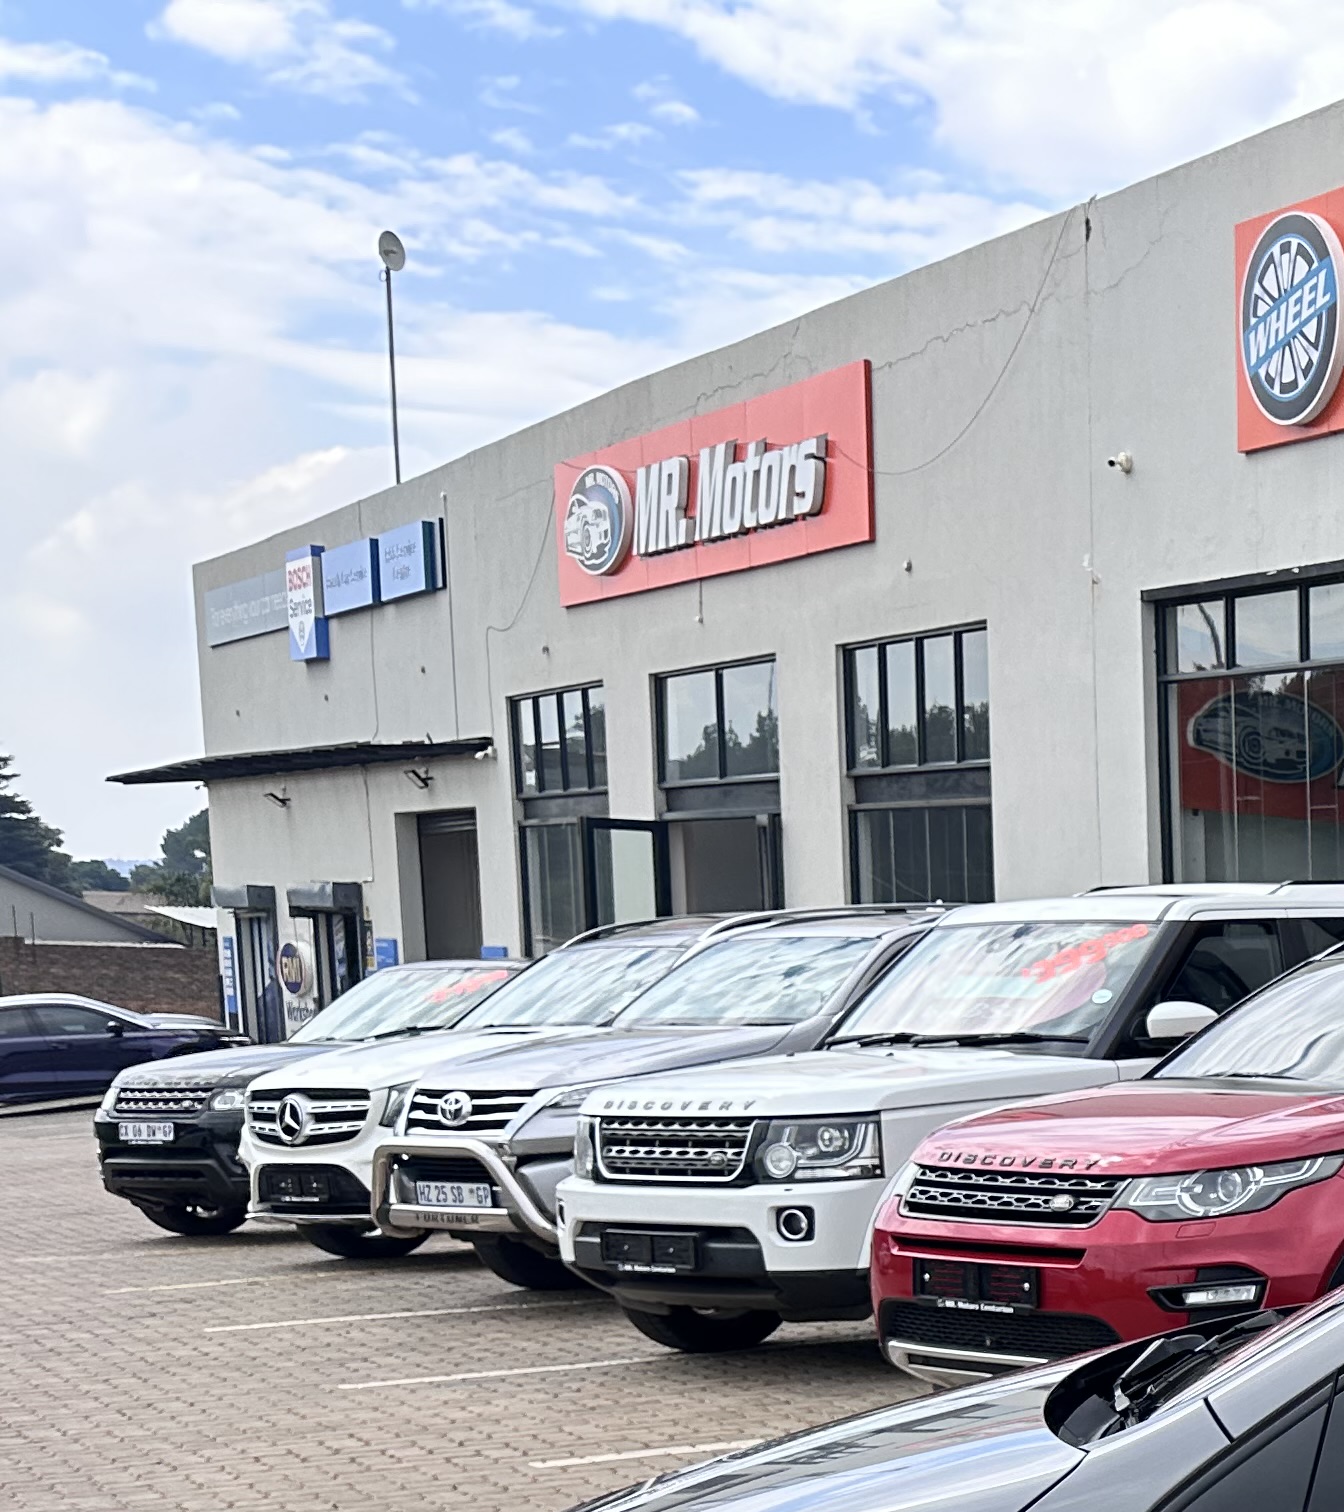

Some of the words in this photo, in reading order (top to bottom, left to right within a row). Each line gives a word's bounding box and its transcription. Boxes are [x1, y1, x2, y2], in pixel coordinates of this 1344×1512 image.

[1248, 270, 1331, 364] WHEEL
[633, 455, 696, 557] MR.
[694, 433, 828, 543] Motors
[287, 564, 312, 592] BOSCH
[289, 595, 312, 618] Service
[603, 1100, 756, 1111] DISCOVERY
[162, 1124, 173, 1138] GP
[938, 1151, 1100, 1170] DISCOVERY
[418, 1183, 431, 1202] HZ
[434, 1184, 448, 1203] 25
[451, 1185, 464, 1204] SB
[475, 1187, 489, 1205] GP
